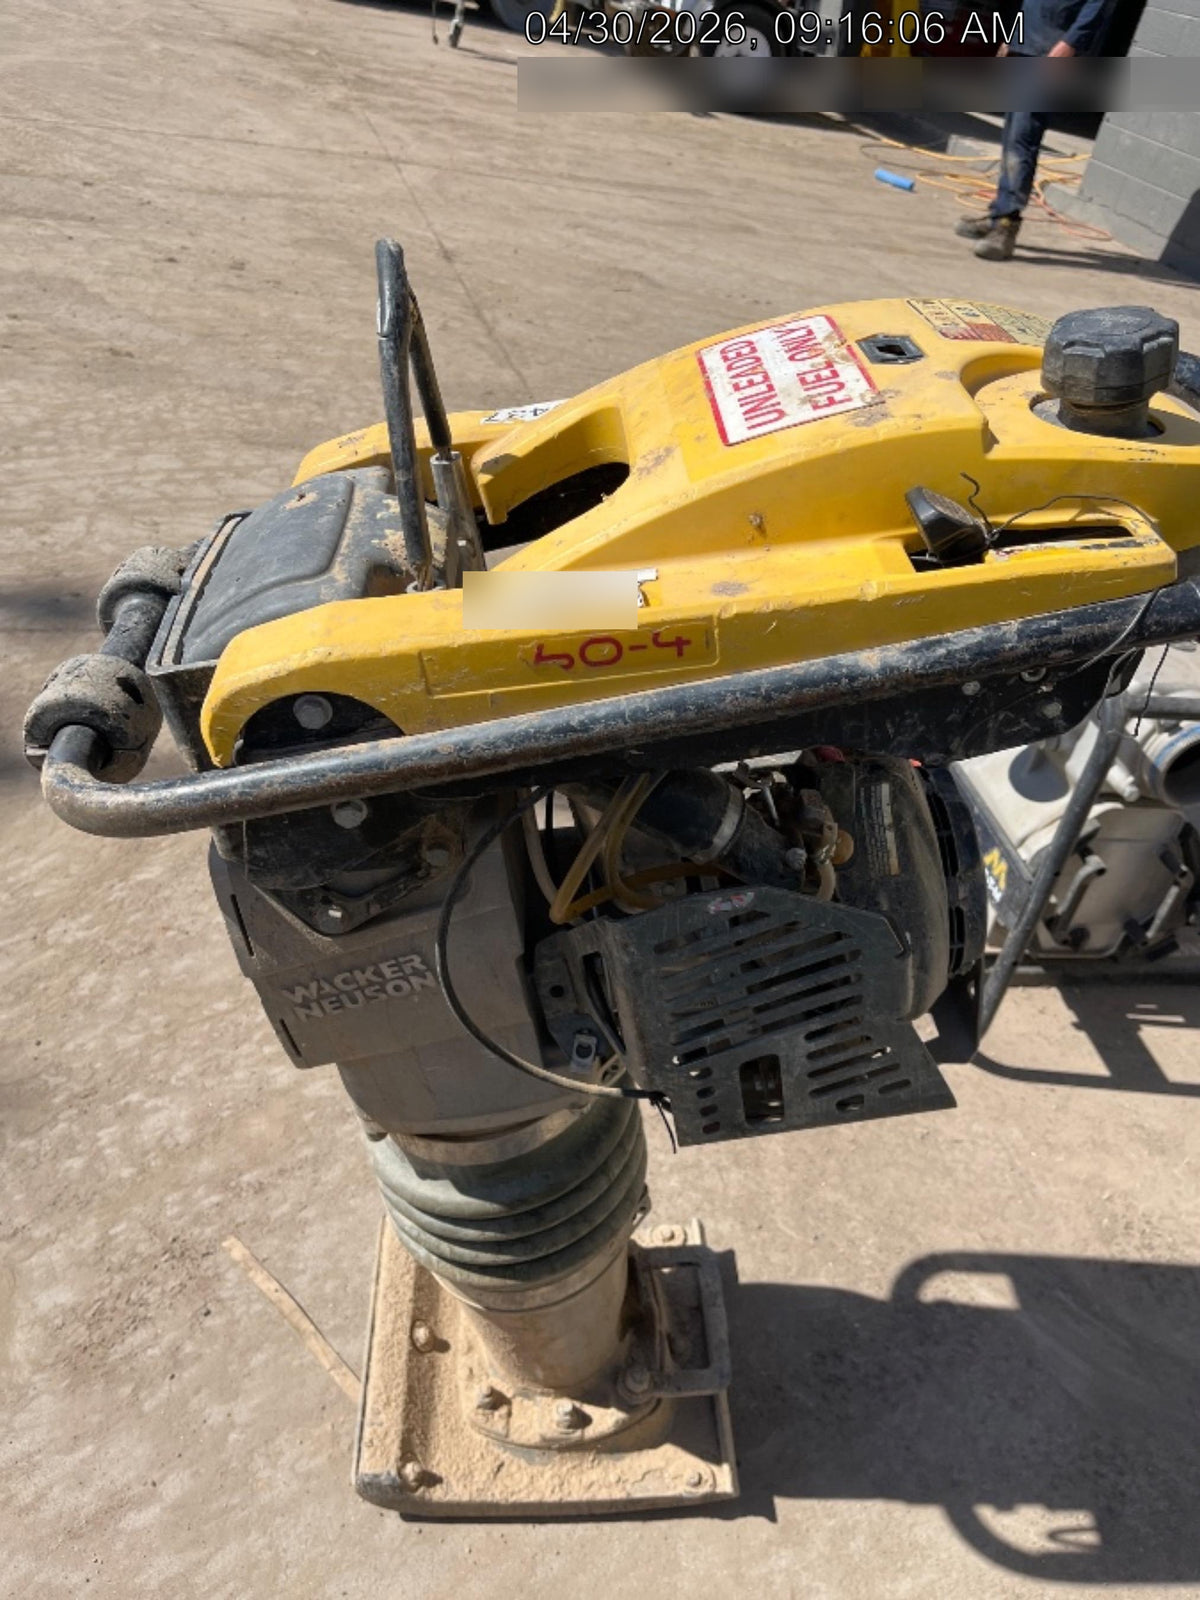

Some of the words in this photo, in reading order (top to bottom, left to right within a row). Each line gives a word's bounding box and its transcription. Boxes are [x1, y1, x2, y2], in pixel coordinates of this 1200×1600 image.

[773, 325, 826, 362] ONLY
[719, 339, 788, 431] UNLEADED
[797, 360, 853, 412] FUEL
[282, 954, 428, 1004] WACKER
[293, 971, 438, 1023] NEUSON
